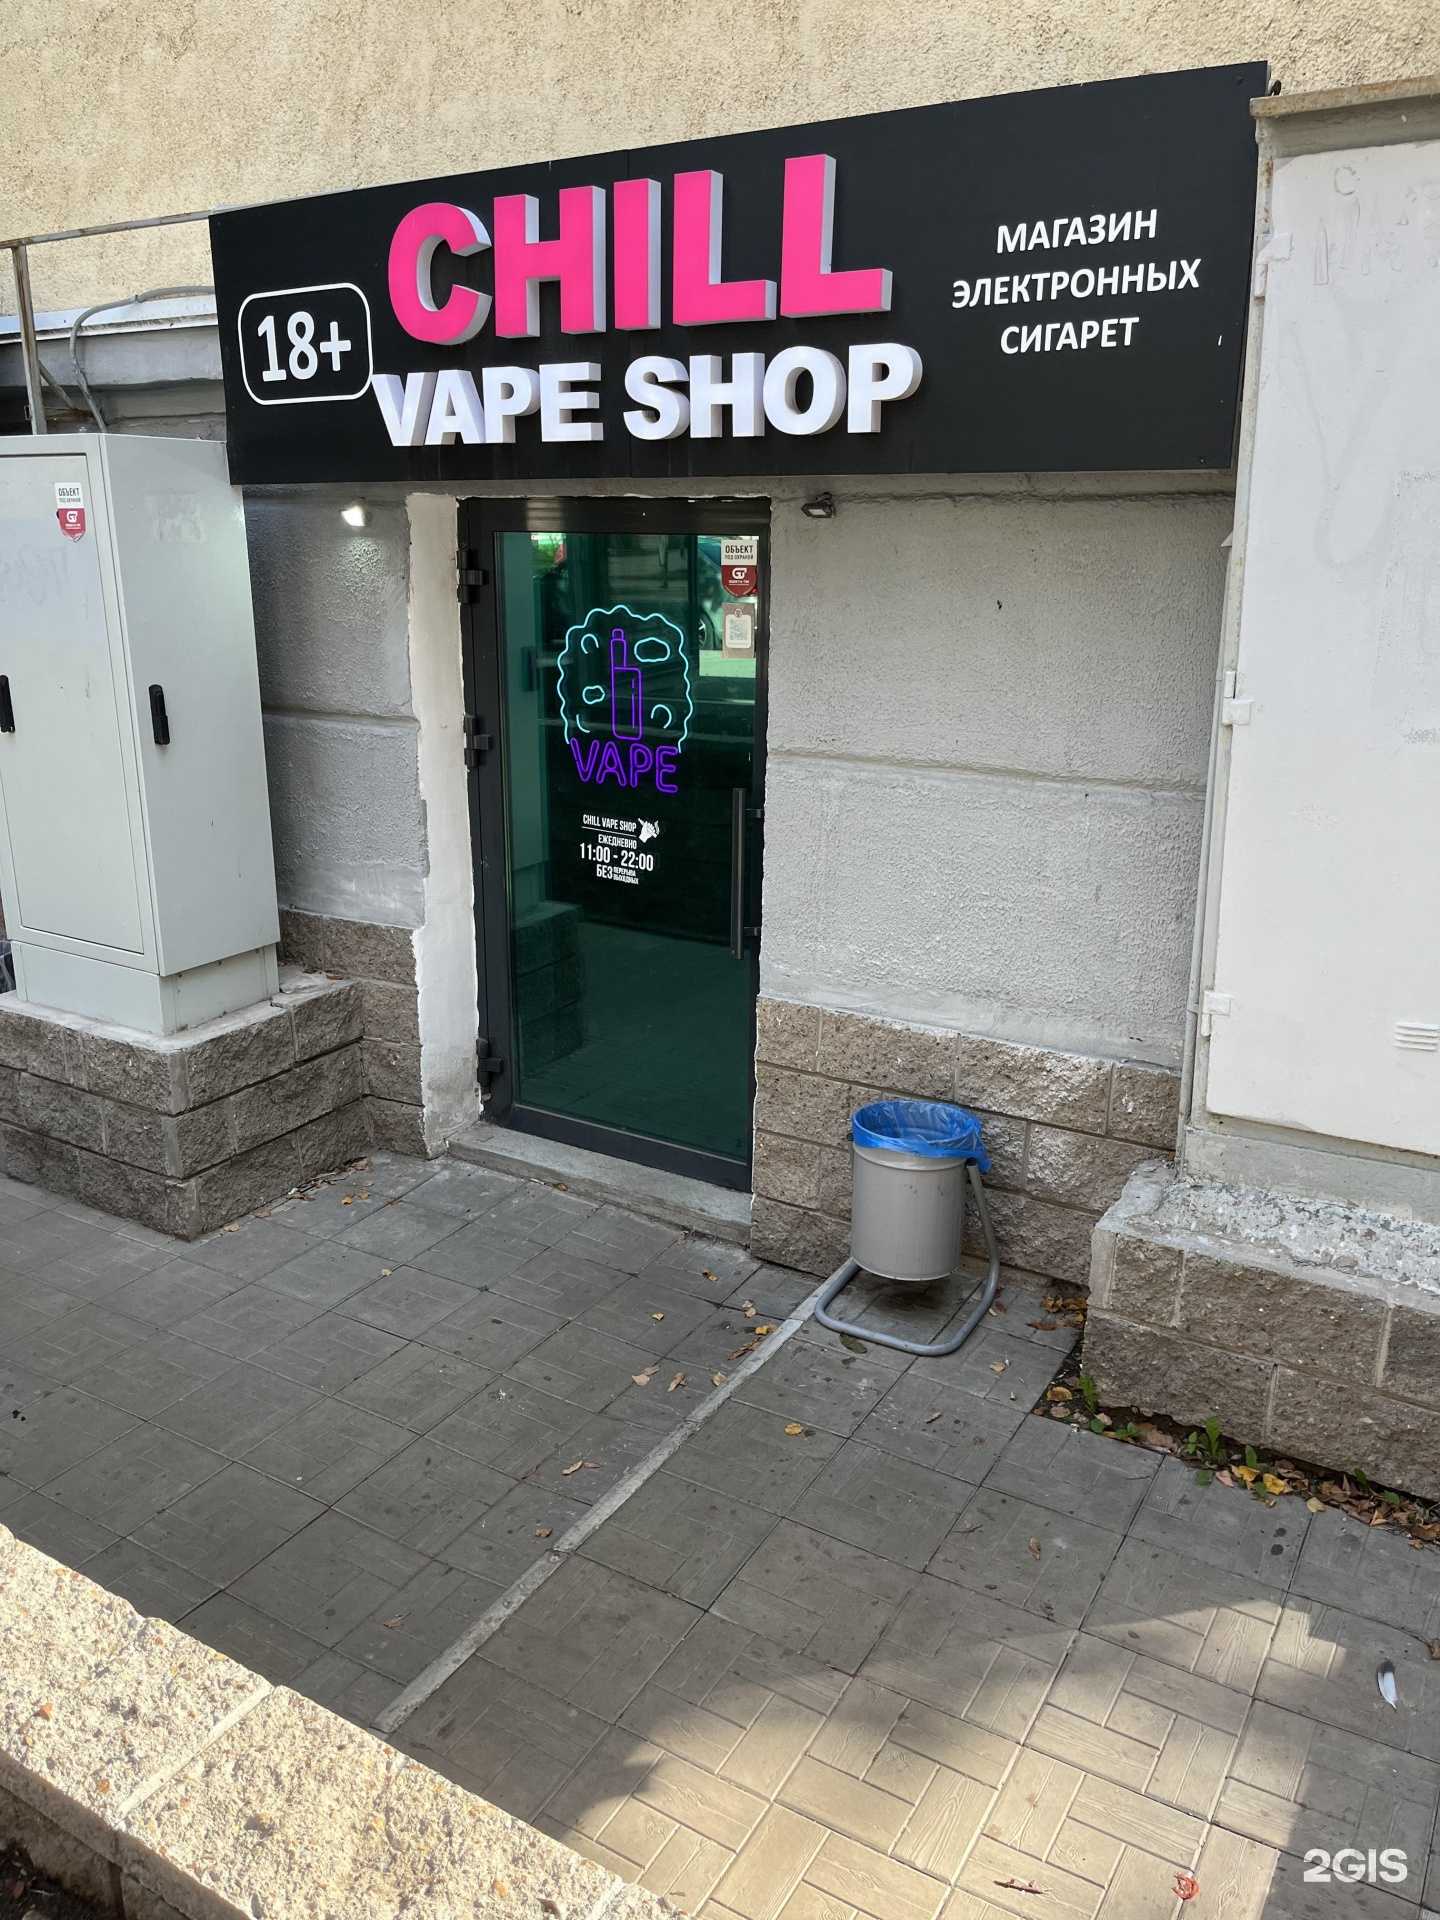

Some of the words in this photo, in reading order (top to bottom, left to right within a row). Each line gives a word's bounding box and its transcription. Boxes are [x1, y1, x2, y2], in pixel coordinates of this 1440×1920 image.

[388, 154, 892, 345] CHILL
[997, 209, 1157, 253] МАГАЗИН
[952, 258, 1201, 308] ЭЛЕКТРОННЫХ
[257, 311, 352, 382] 18+
[1000, 317, 1139, 354] СИГАРЕТ
[372, 362, 604, 447] VAPE
[622, 341, 923, 440] SHOP
[725, 544, 753, 554] ОБЪЕКТ
[570, 737, 679, 793] VAPE
[583, 814, 600, 826] CHILL
[602, 818, 618, 829] VAPE
[620, 820, 636, 832] SHOP
[598, 834, 637, 849] ЕЖЕДНЕВНО
[580, 842, 610, 863] 11:00
[620, 849, 653, 871] 22:00
[597, 864, 613, 879] БЕЗ
